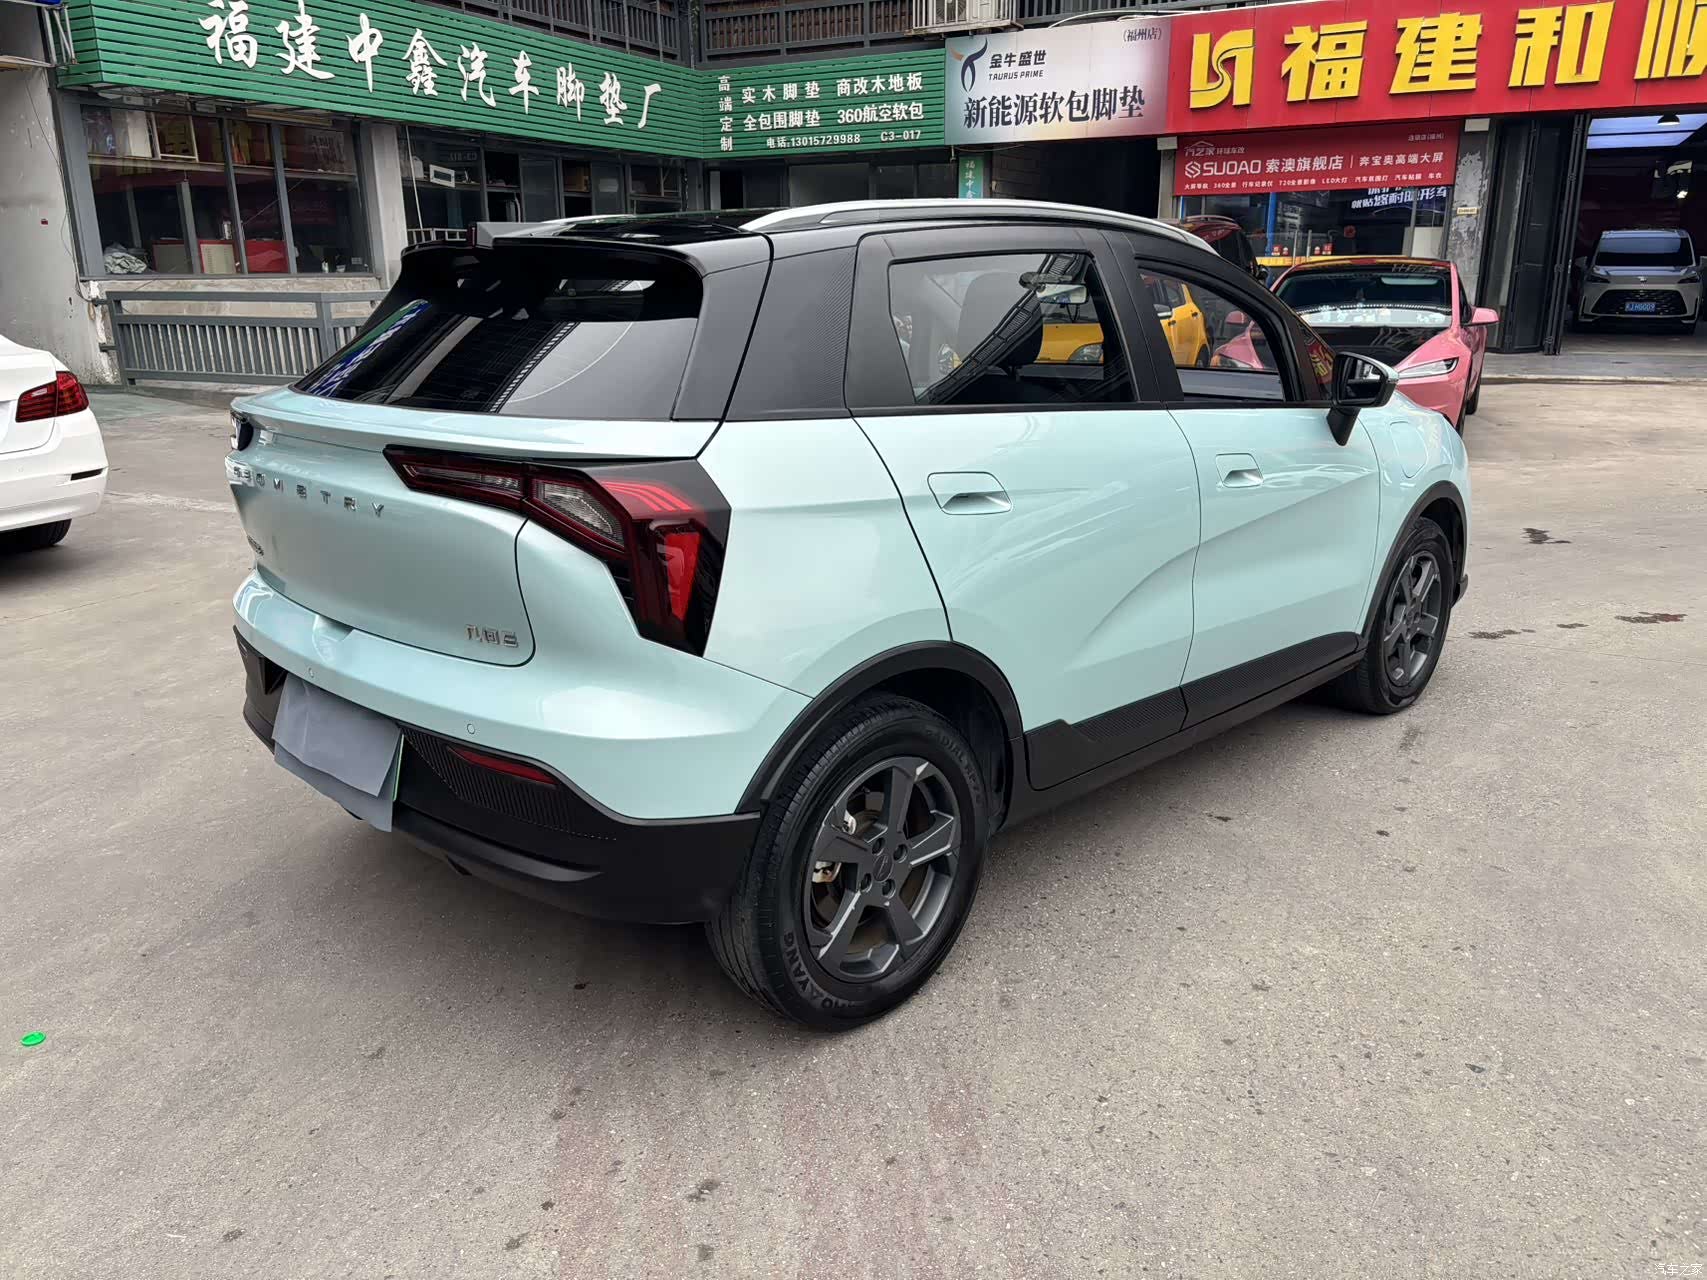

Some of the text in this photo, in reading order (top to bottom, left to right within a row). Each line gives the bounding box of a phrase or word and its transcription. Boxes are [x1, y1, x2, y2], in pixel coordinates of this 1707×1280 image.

[199, 0, 662, 129] 福建中鑫汽车脚垫厂
[989, 50, 1047, 69] 金牛盛世
[741, 72, 924, 105] 实木脚垫 商改木地板
[989, 69, 1044, 81] TAURUS PRIME
[717, 75, 734, 152] 高端定制
[743, 102, 925, 132] 全包围脚垫 360航空软包
[963, 85, 1146, 129] 新能源软包脚垫
[766, 130, 922, 149] 电话:13015729988 C3-017
[1202, 151, 1444, 176] SUOAO 索澳旗舰店 奔宝奥高端大屏
